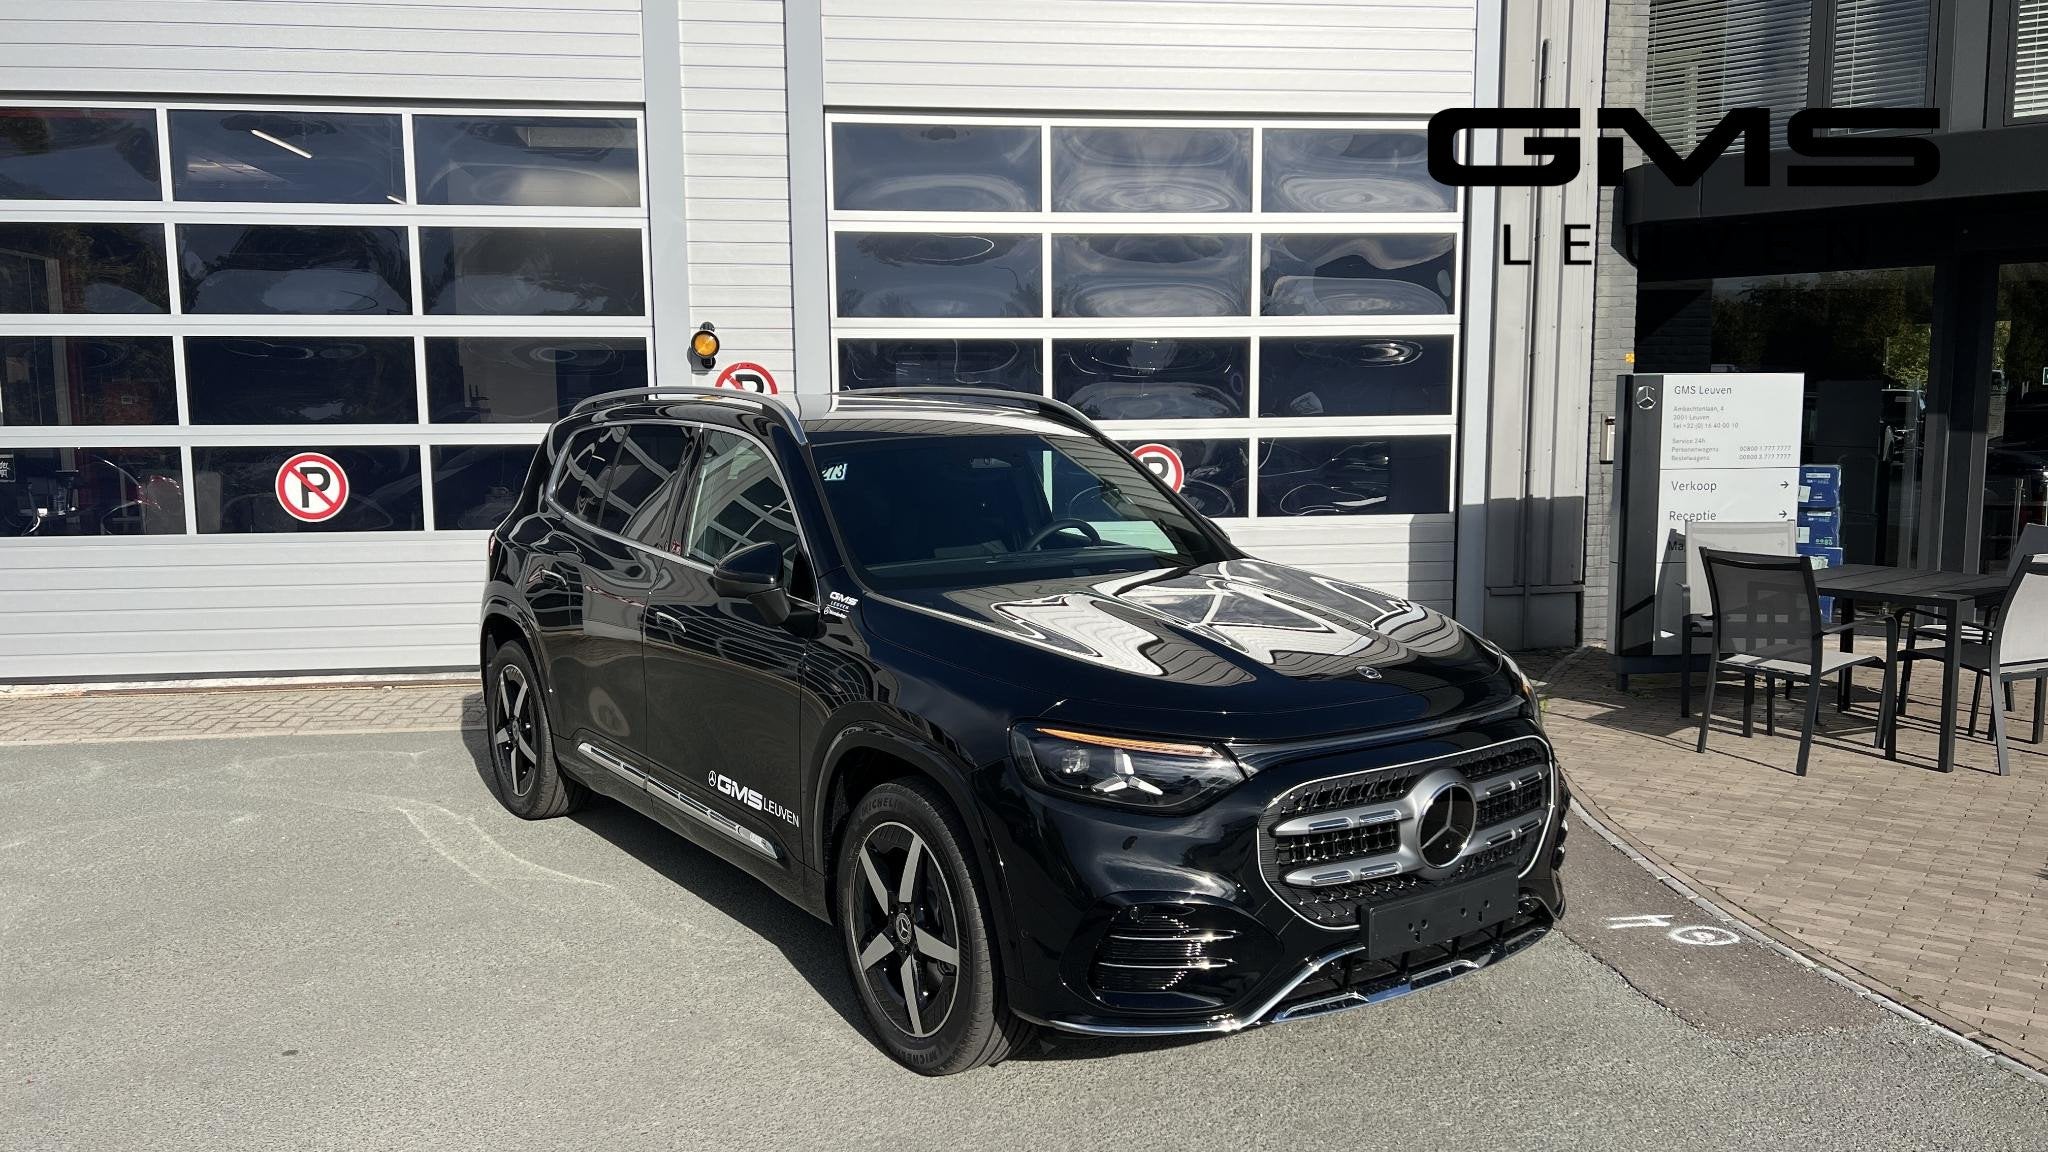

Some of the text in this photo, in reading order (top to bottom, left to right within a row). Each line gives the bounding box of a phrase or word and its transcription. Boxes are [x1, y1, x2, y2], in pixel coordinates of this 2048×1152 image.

[1674, 385, 1732, 395] GMS Leuven
[1671, 481, 1717, 493] Verkoop
[1669, 511, 1717, 522] Receptie
[829, 591, 859, 606] GMS
[717, 773, 800, 828] GMS LEUVEN
